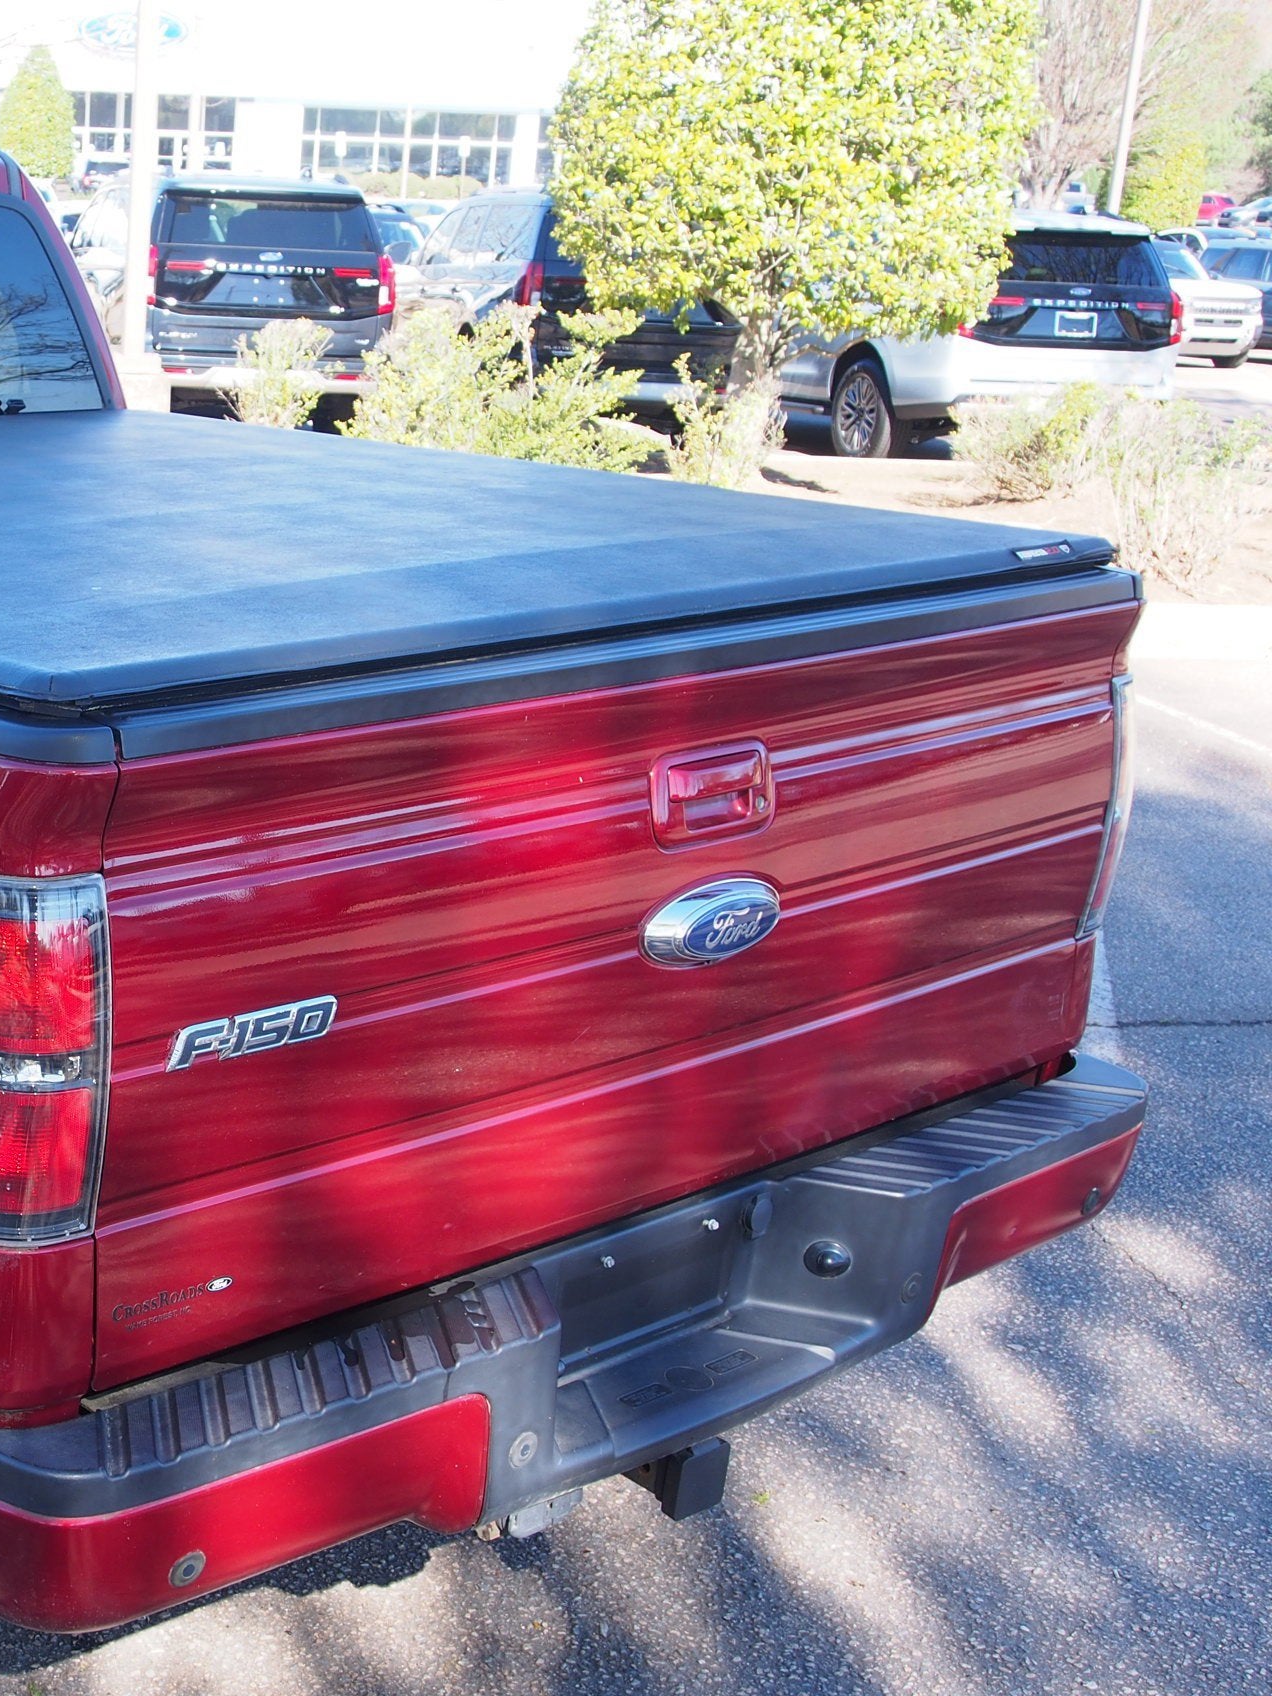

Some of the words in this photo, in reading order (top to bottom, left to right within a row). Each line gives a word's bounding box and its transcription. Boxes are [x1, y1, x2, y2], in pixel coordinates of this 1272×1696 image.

[216, 262, 326, 275] EXPEDITION
[1032, 298, 1130, 309] EXPEDITION
[705, 906, 763, 950] Ford
[165, 994, 338, 1073] F-150
